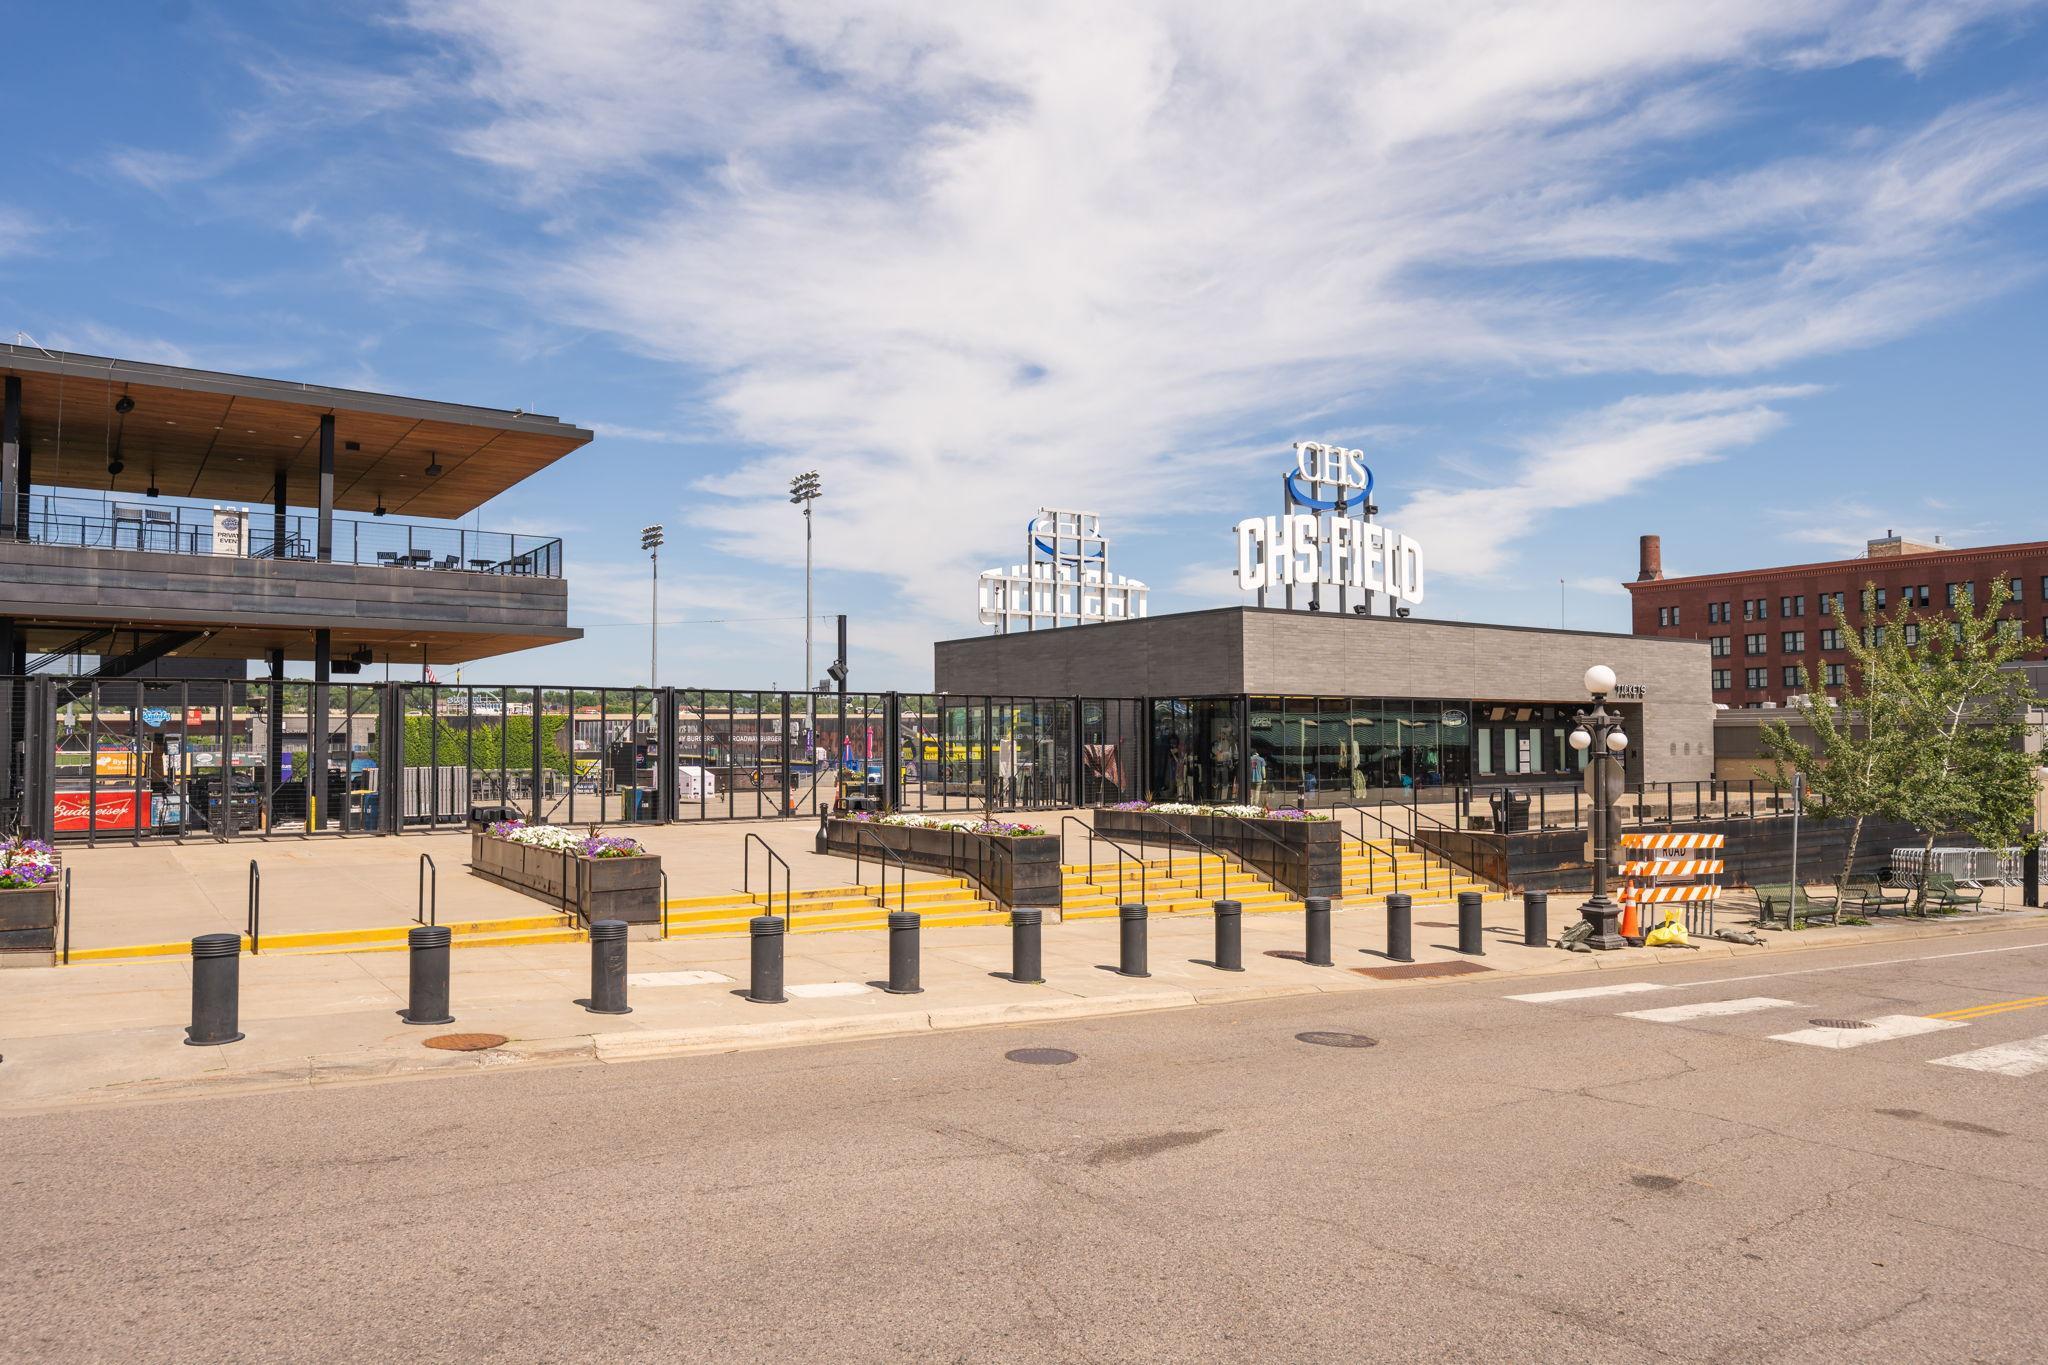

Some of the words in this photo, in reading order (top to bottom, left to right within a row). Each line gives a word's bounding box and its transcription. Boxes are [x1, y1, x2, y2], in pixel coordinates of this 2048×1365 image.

[1296, 441, 1367, 490] CHS
[1238, 514, 1319, 590] CHS
[1329, 516, 1424, 605] FIELD
[1615, 684, 1647, 695] TICKETS
[1662, 848, 1686, 857] ROAD
